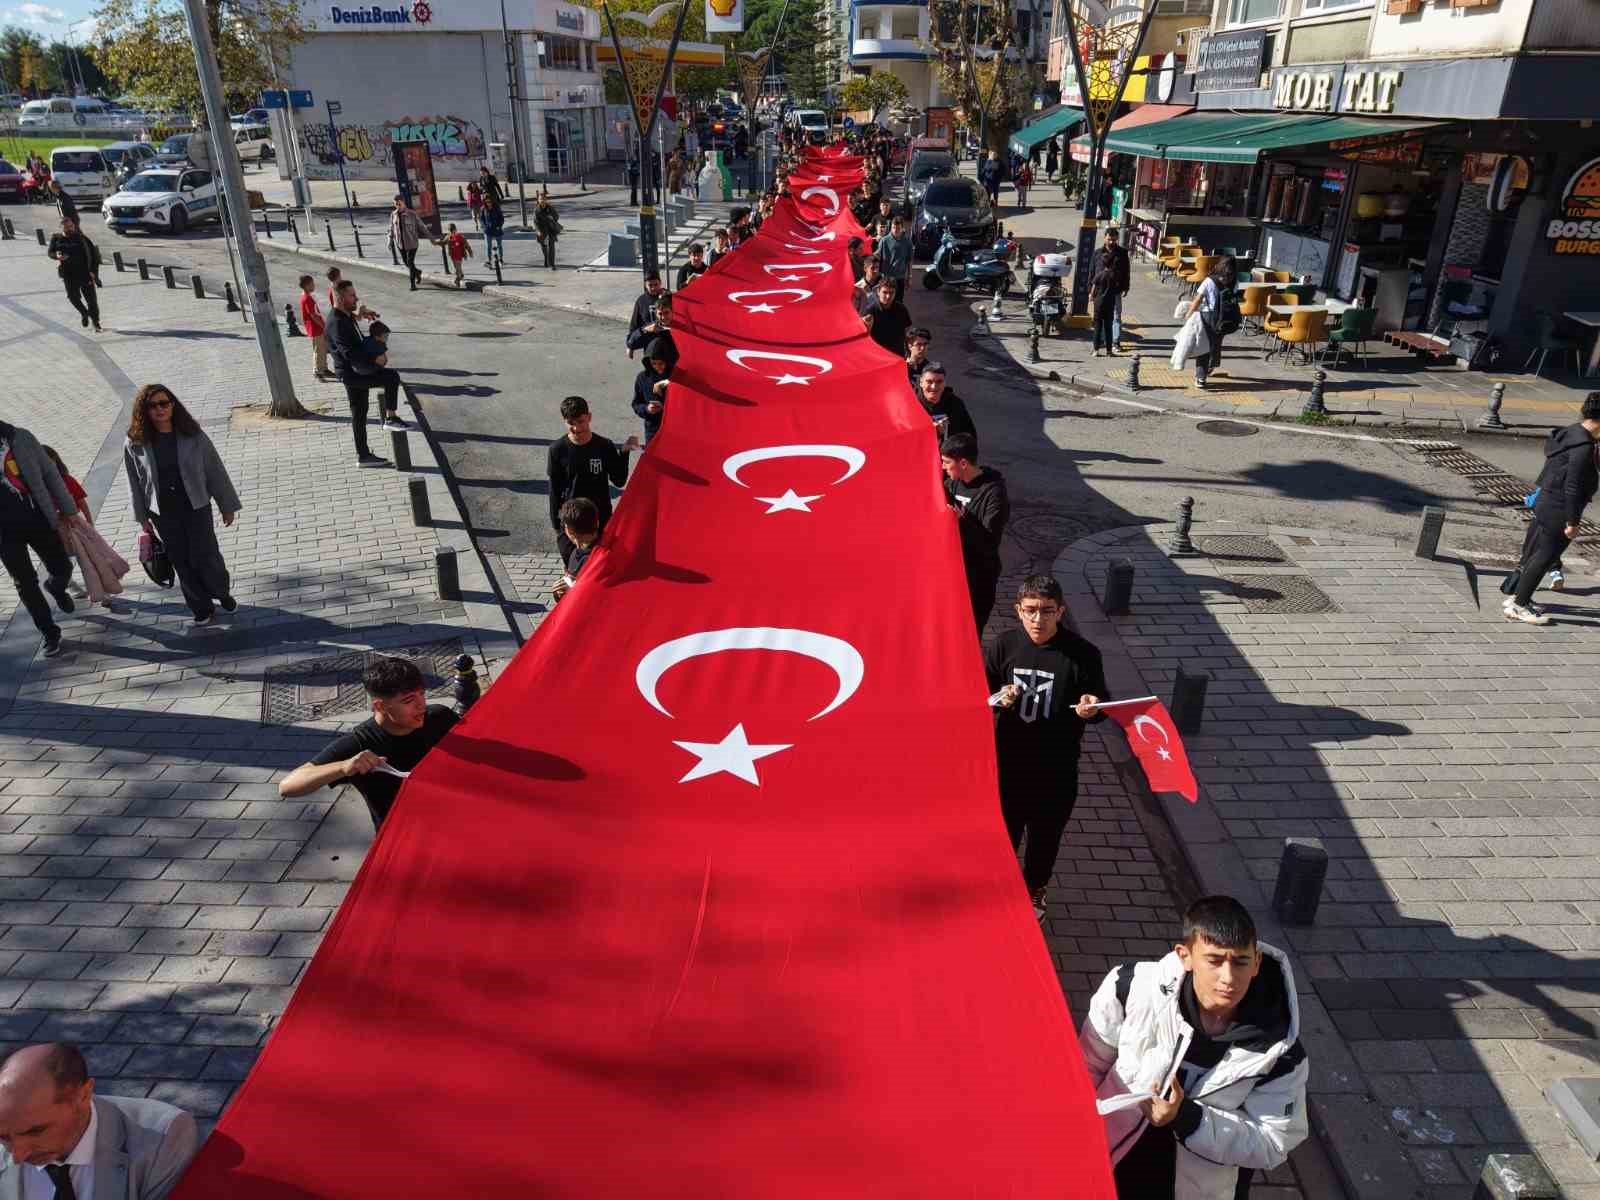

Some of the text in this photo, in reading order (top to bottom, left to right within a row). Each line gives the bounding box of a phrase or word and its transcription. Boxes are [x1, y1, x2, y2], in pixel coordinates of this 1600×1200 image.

[331, 6, 411, 24] DenizBank
[1273, 72, 1402, 113] MOR TAT
[1546, 219, 1600, 240] BOSS
